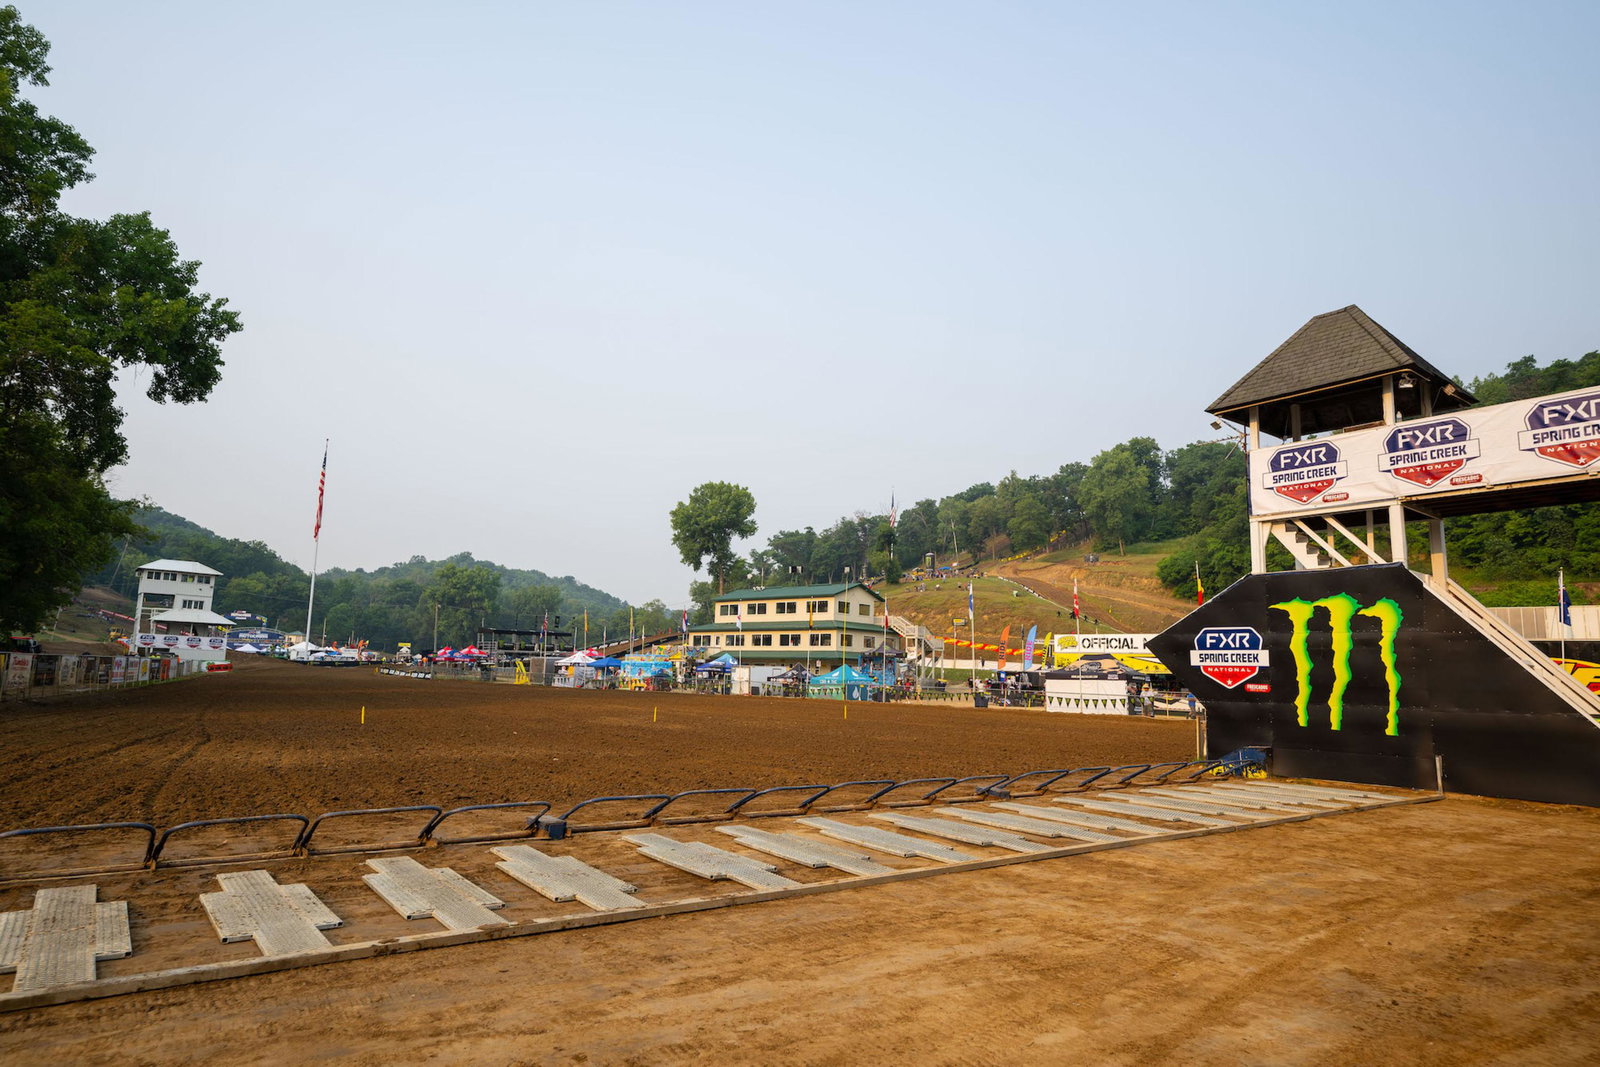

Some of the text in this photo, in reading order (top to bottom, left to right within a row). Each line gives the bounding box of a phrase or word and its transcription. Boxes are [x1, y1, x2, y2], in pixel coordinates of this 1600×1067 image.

[1398, 424, 1454, 448] FXR
[1533, 427, 1580, 444] SPRING
[1280, 447, 1327, 468] FXR
[1390, 445, 1467, 466] SPRING CREEK
[1272, 466, 1337, 484] SPRING CREEK
[1400, 462, 1457, 474] NATIONAL
[1282, 482, 1329, 492] NATIONAL
[1082, 638, 1138, 650] OFFICIAL
[1206, 633, 1250, 648] FXR
[1199, 653, 1260, 662] SPRING CREEK
